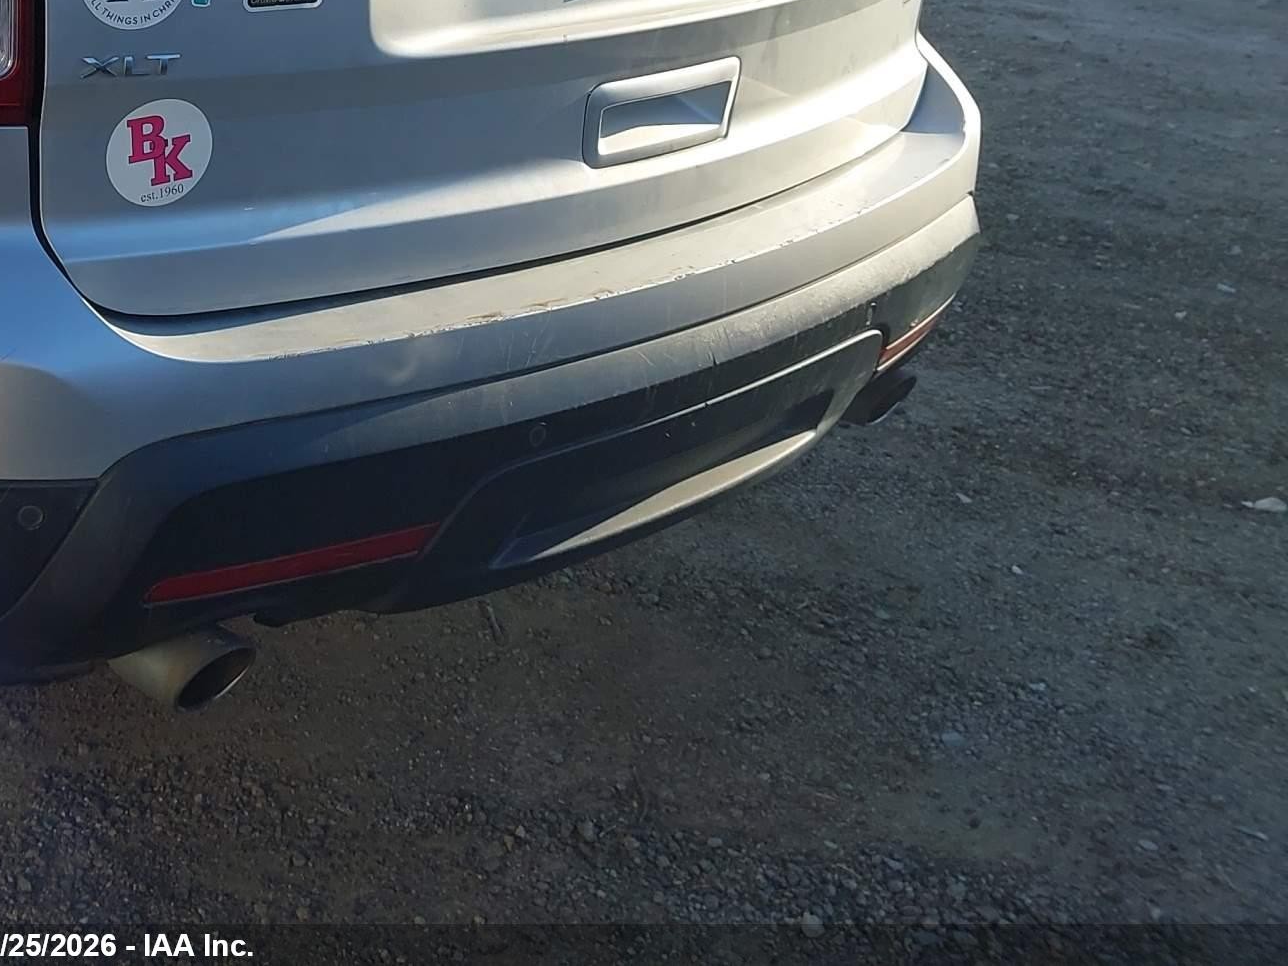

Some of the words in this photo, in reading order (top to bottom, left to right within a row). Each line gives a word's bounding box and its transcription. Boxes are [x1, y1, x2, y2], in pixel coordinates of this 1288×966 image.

[102, 7, 138, 25] THINGS
[140, 14, 151, 24] IN
[80, 53, 182, 79] XLT
